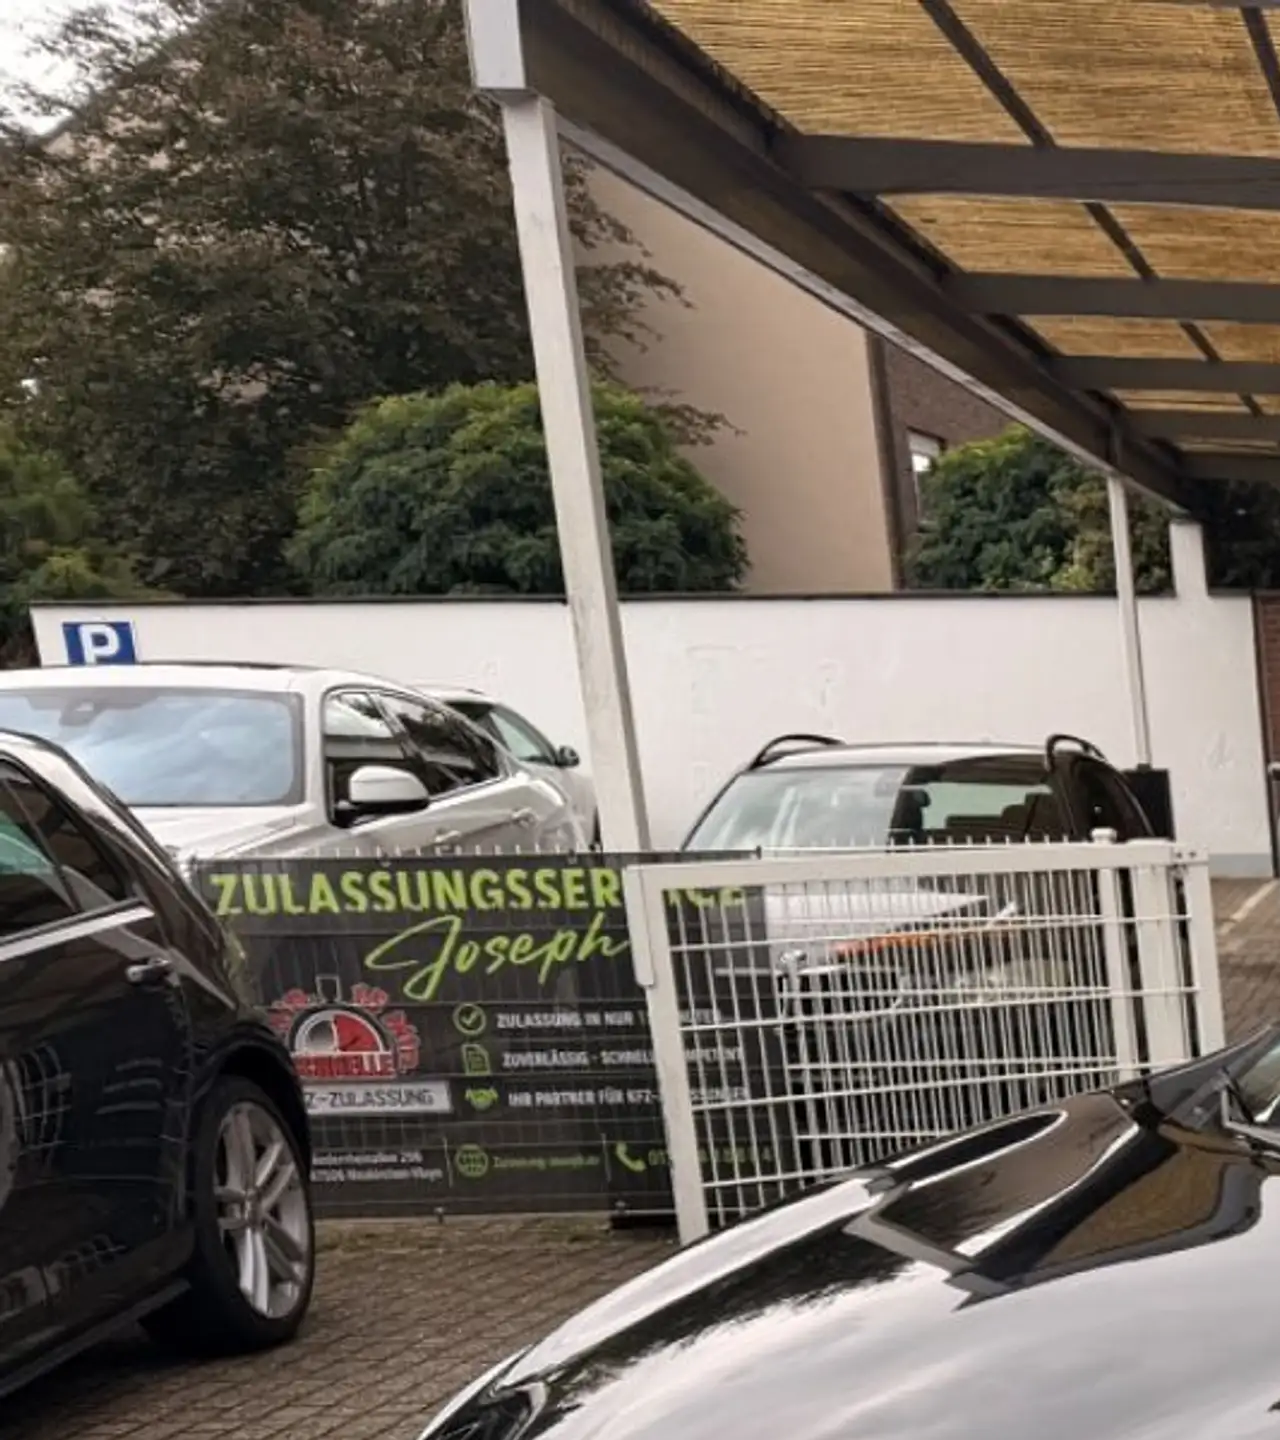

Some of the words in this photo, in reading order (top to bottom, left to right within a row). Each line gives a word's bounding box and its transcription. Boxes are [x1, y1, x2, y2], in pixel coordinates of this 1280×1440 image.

[78, 623, 121, 664] P
[364, 910, 629, 1000] Joseph
[496, 1012, 581, 1029] ZULASSUNG
[604, 1010, 633, 1026] NUR
[535, 1089, 594, 1106] PARTNER
[598, 1086, 624, 1104] FÜR
